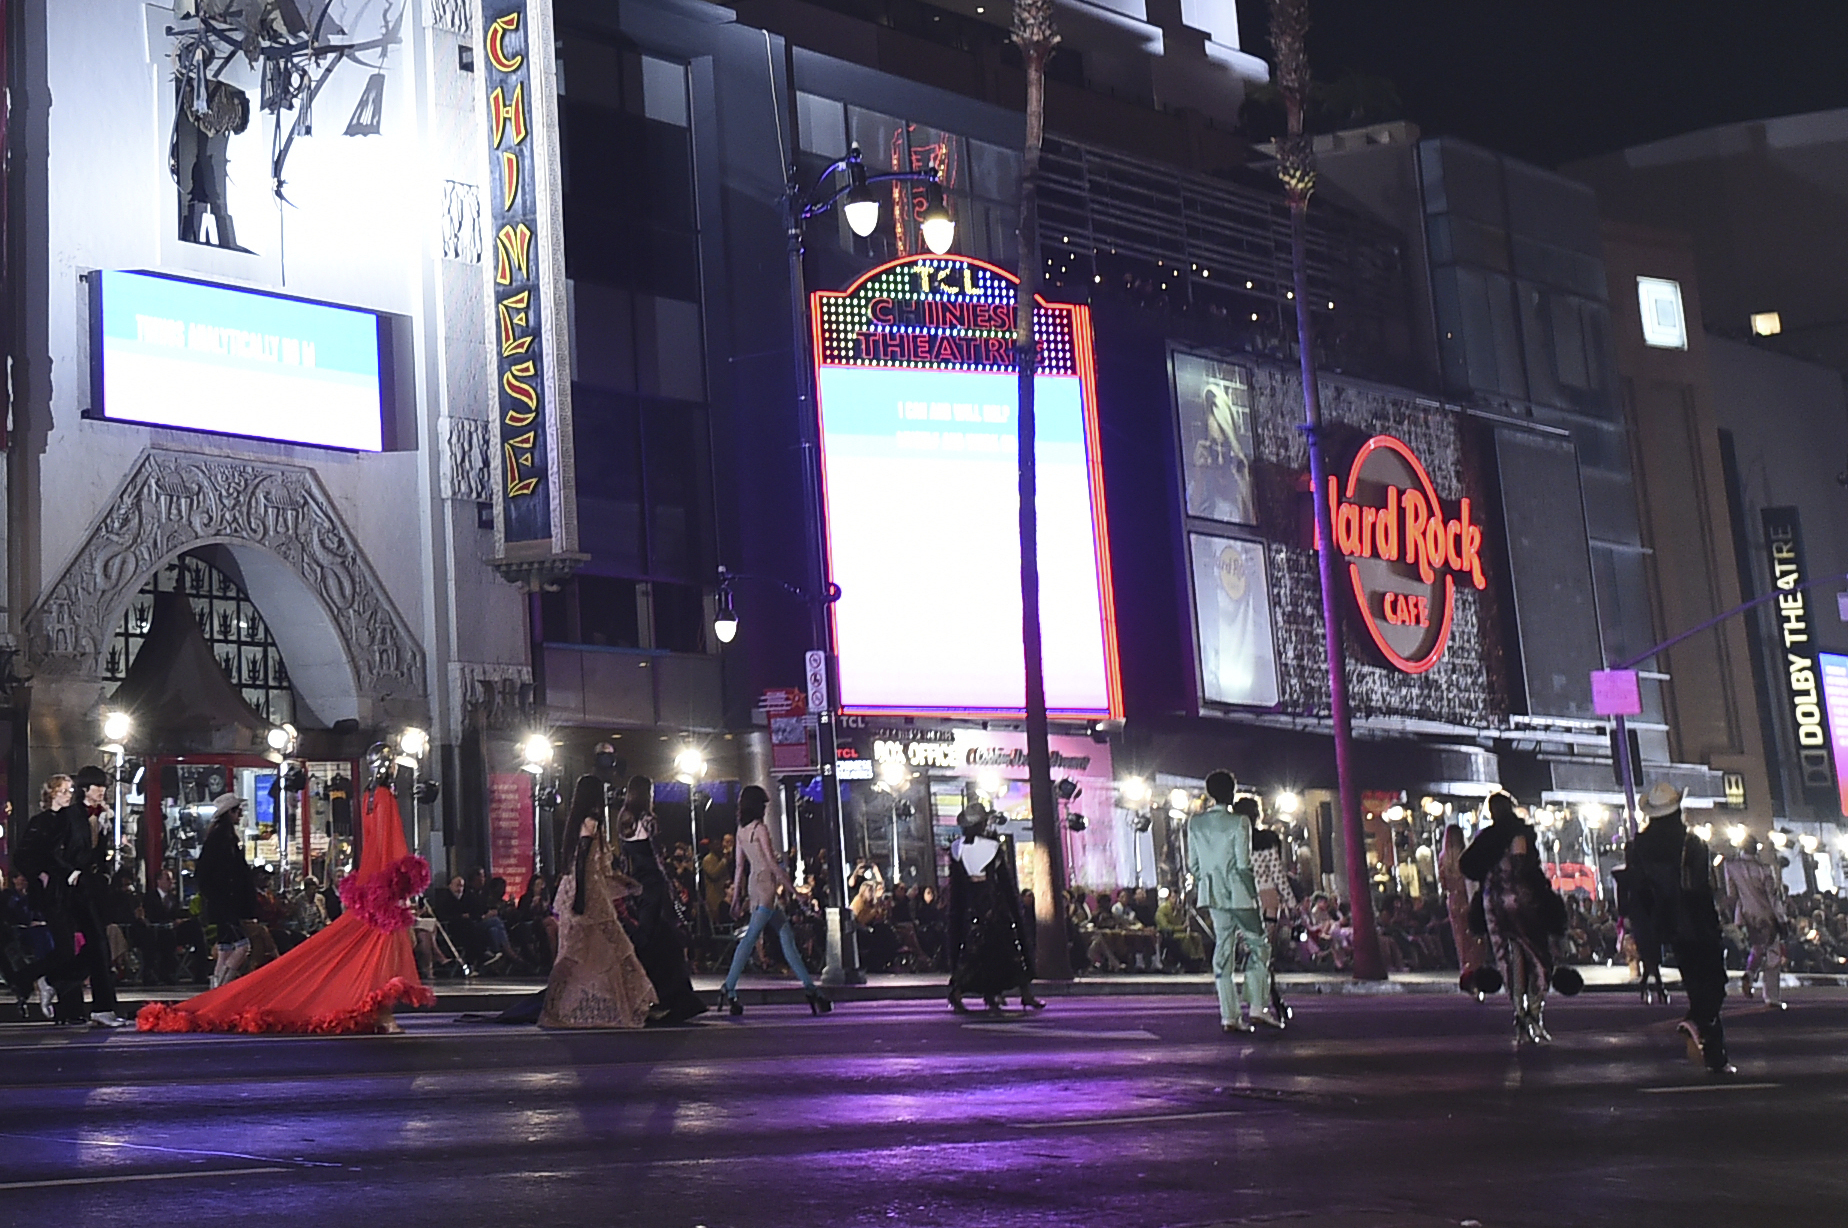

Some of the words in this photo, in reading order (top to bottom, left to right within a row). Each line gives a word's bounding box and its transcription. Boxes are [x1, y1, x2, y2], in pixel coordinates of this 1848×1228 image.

[486, 11, 539, 499] CHINESE
[913, 265, 981, 295] TCL
[855, 332, 1046, 369] THEATRS
[1402, 488, 1487, 590] Rock
[1770, 523, 1808, 649] THEATRE
[1384, 592, 1429, 628] CAFE
[1788, 653, 1824, 747] DOLBY
[840, 715, 865, 728] TCL
[836, 747, 859, 758] TCL
